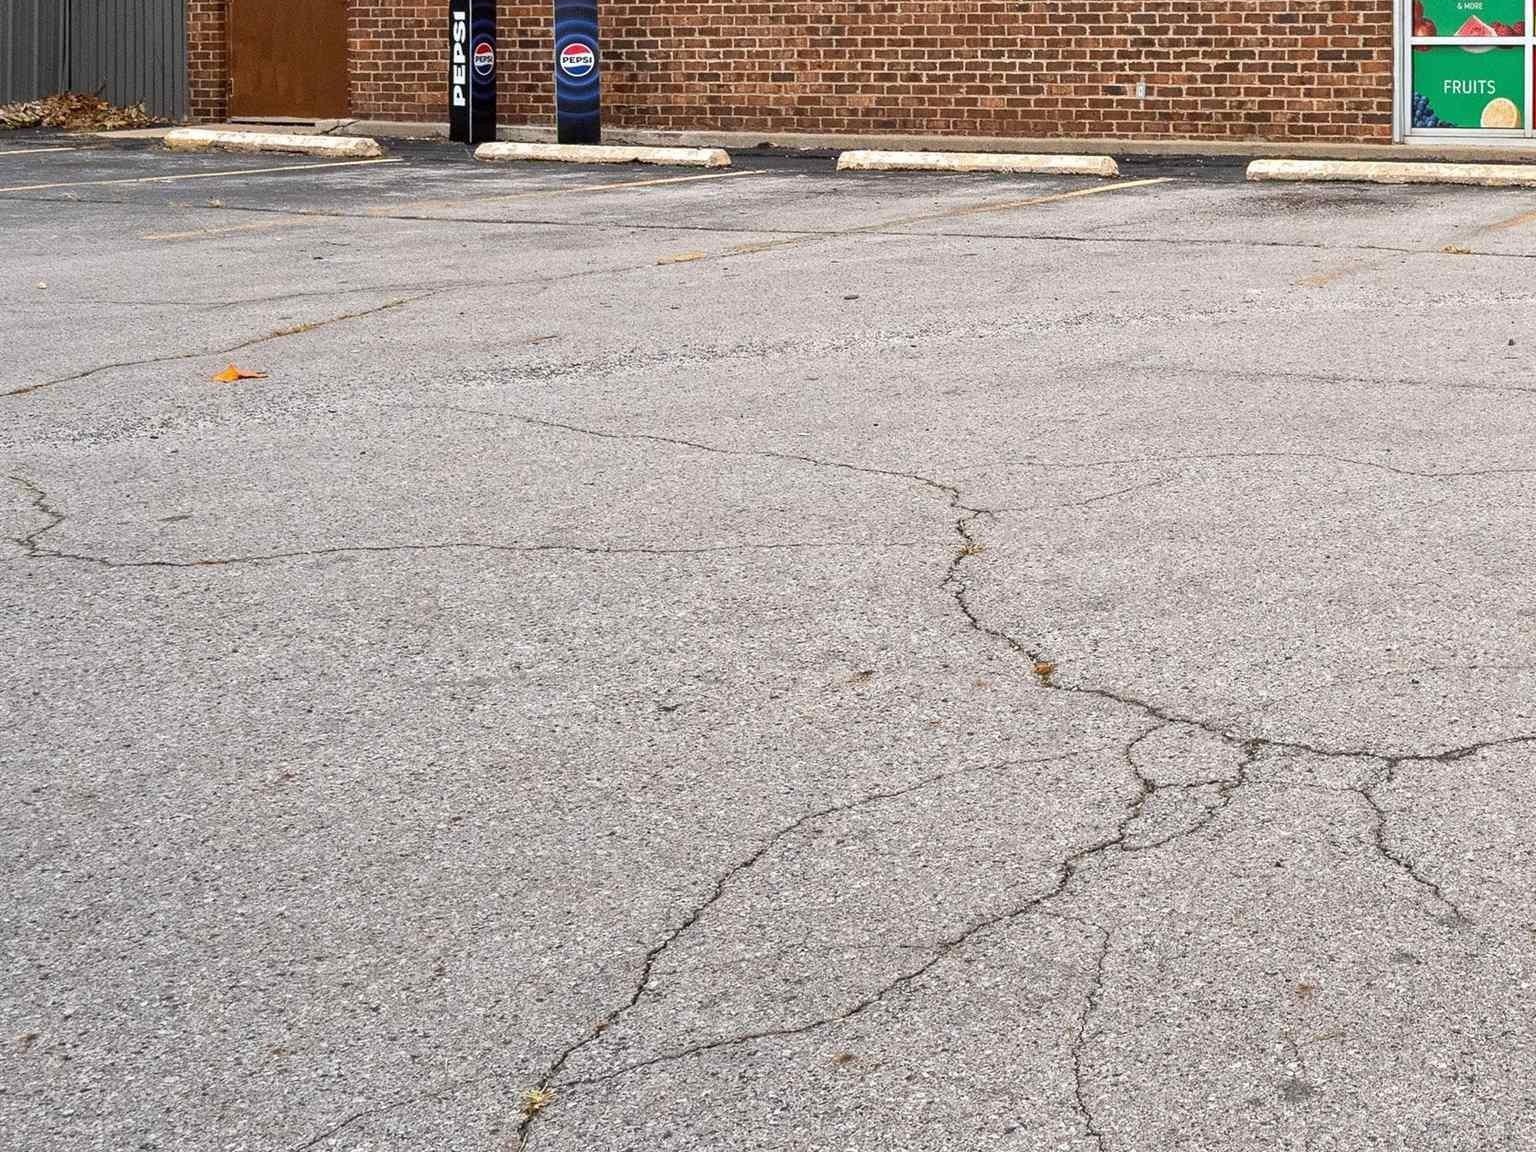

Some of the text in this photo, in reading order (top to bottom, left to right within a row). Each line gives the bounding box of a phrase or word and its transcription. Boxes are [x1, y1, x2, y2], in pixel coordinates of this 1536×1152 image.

[453, 11, 466, 107] PEPSI
[475, 54, 493, 64] PEPSI
[562, 56, 593, 64] PEPSI
[1443, 79, 1496, 95] FRUITS
